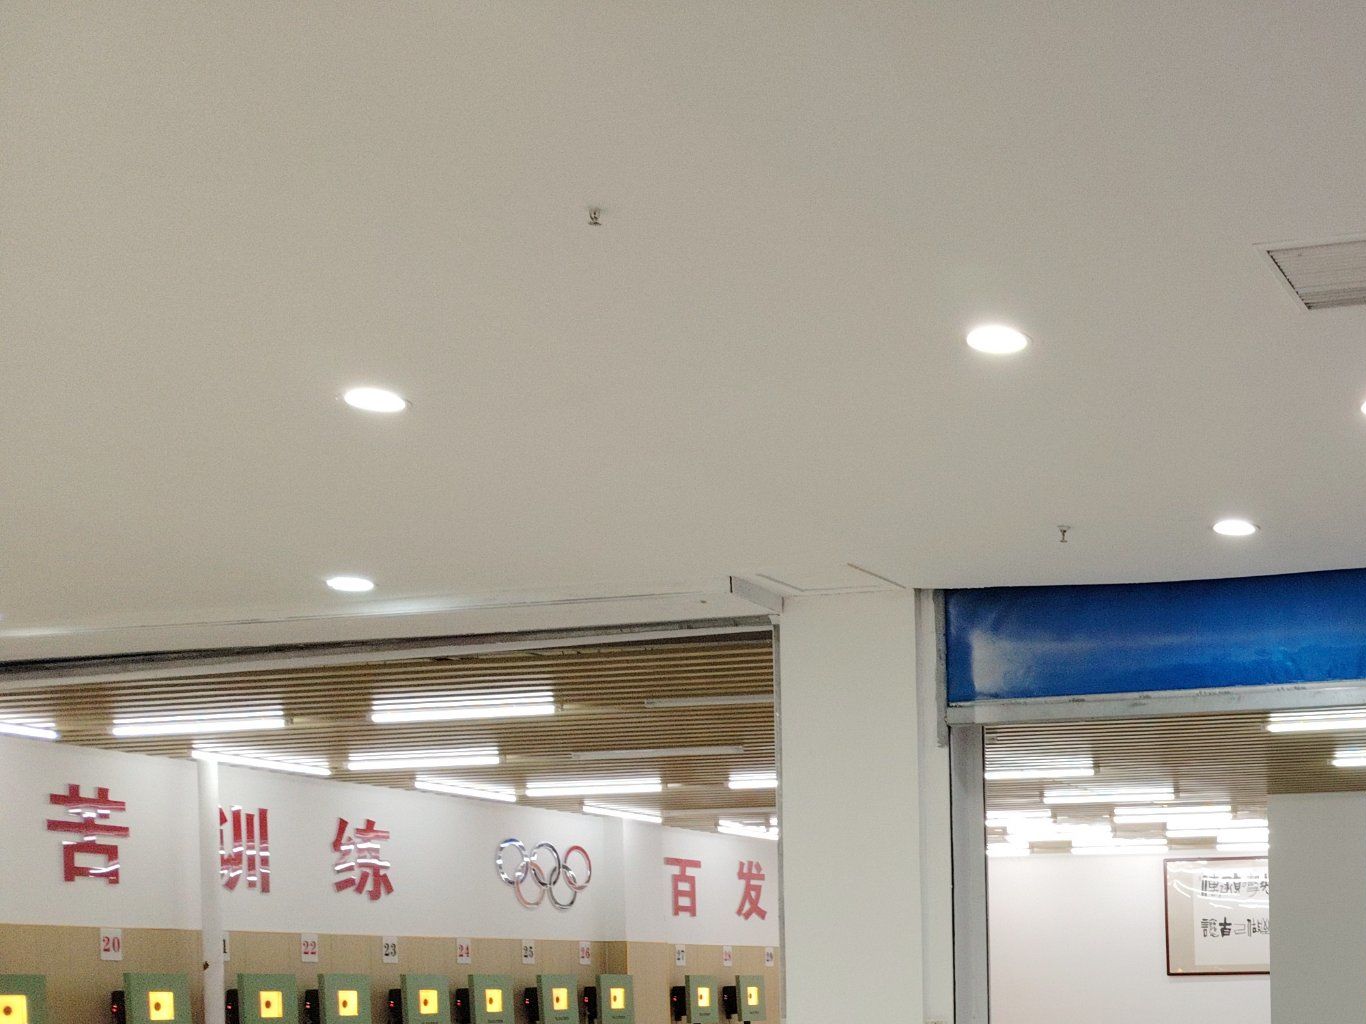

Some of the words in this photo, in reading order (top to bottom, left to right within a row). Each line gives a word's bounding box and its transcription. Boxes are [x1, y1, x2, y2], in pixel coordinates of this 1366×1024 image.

[101, 935, 121, 953] 20
[302, 940, 317, 955] 22
[384, 943, 397, 957] 23
[458, 944, 470, 958] 24
[523, 945, 534, 959] 25
